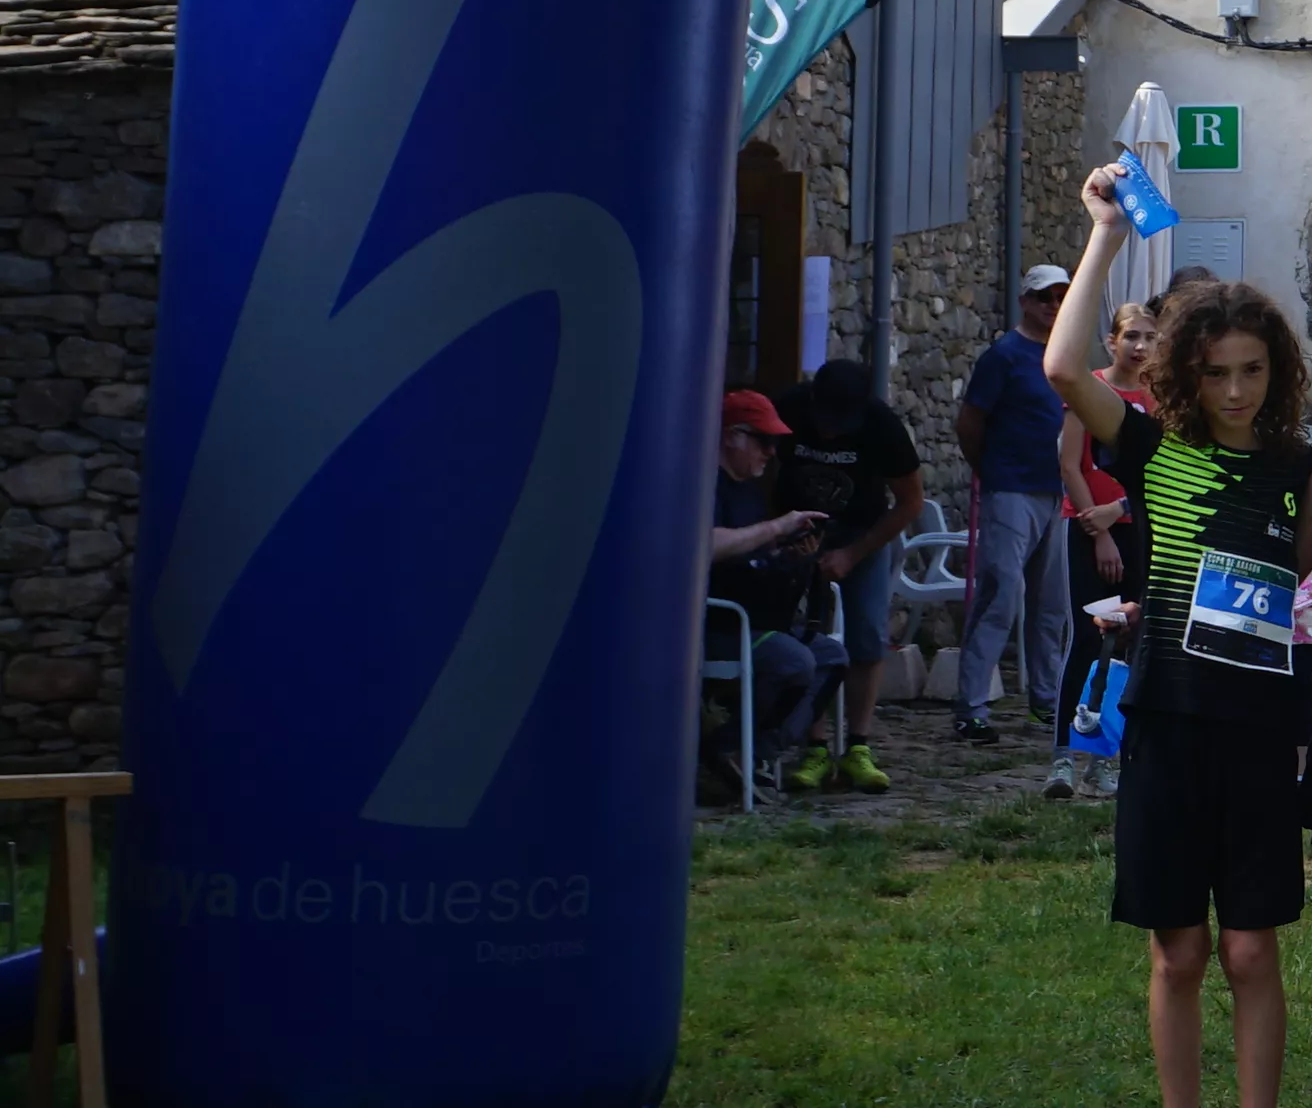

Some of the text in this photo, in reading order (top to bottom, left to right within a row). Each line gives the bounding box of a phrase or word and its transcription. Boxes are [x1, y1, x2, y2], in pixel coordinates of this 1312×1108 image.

[1191, 112, 1225, 146] R
[1232, 580, 1271, 615] 76
[252, 859, 334, 923] de
[349, 862, 591, 925] huesca
[476, 936, 587, 965] Deportes
